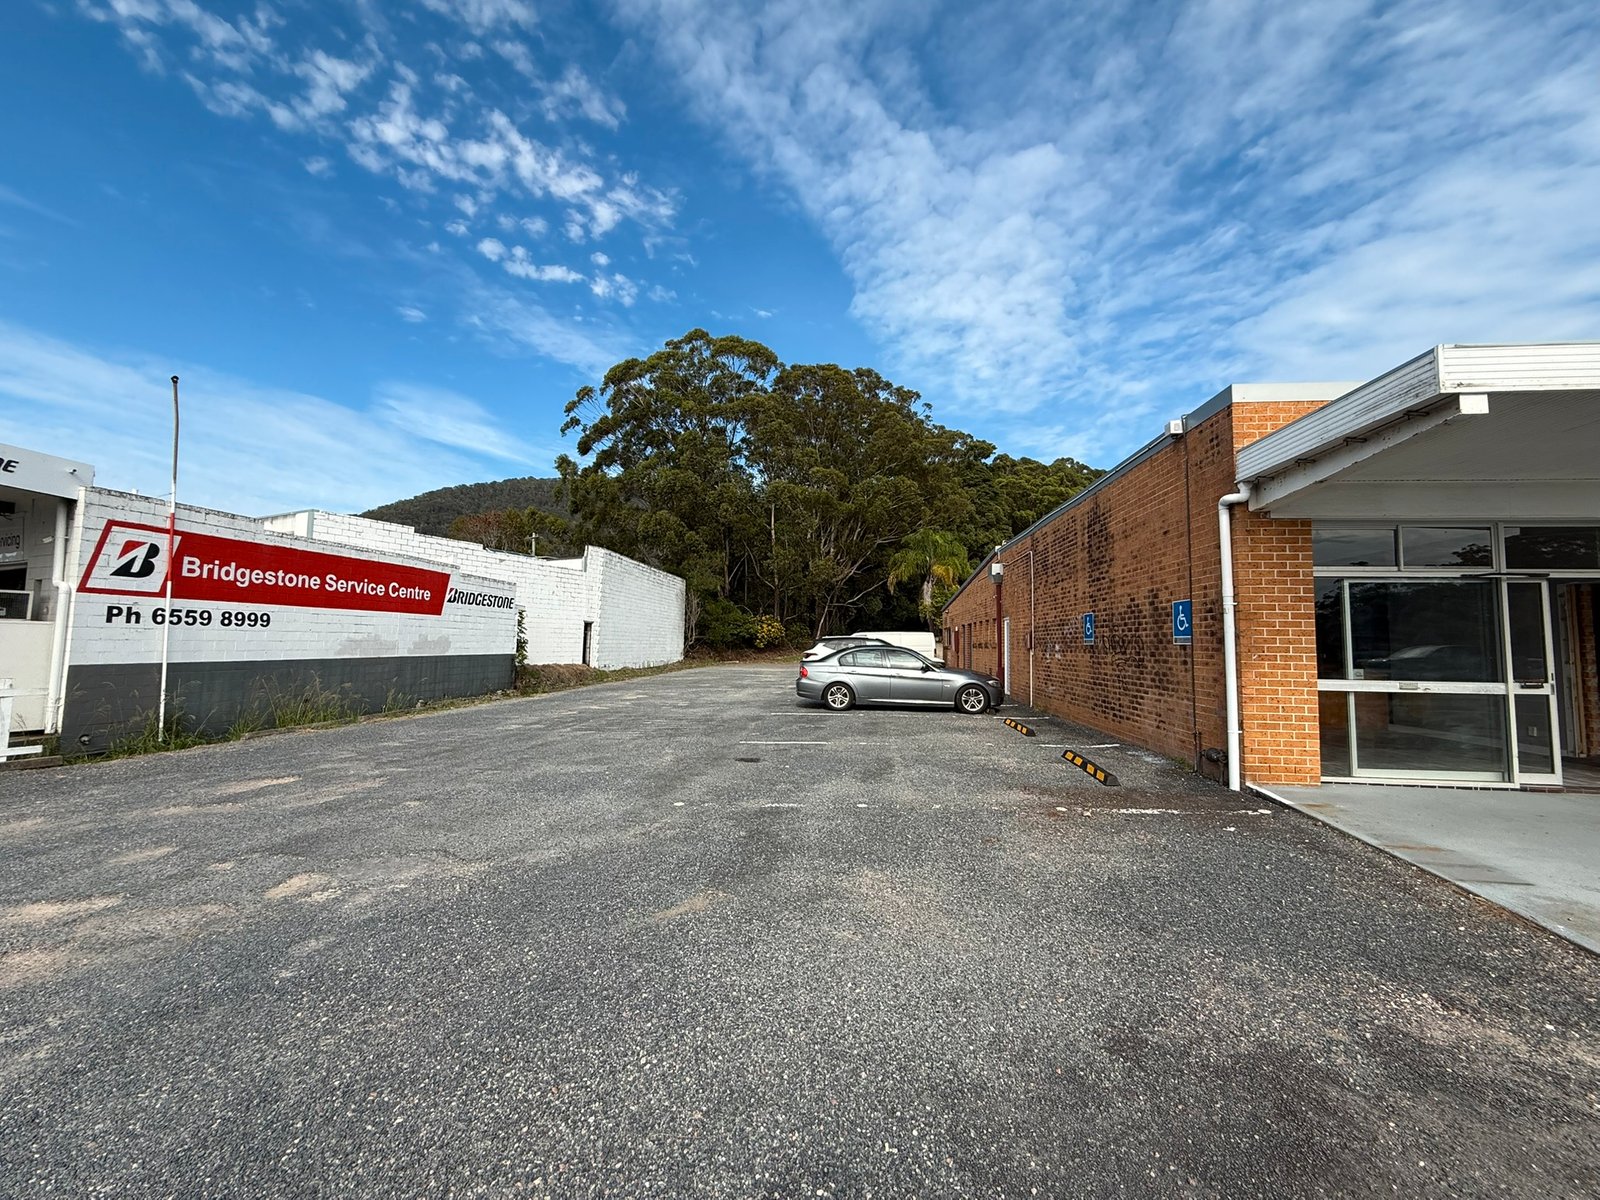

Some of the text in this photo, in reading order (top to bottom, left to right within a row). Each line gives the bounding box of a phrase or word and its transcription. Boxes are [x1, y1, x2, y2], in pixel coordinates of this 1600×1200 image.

[181, 556, 431, 601] Bridgestone Service Centre
[447, 588, 515, 609] BRIDGESTONE
[105, 606, 271, 628] Ph 6559 8999
